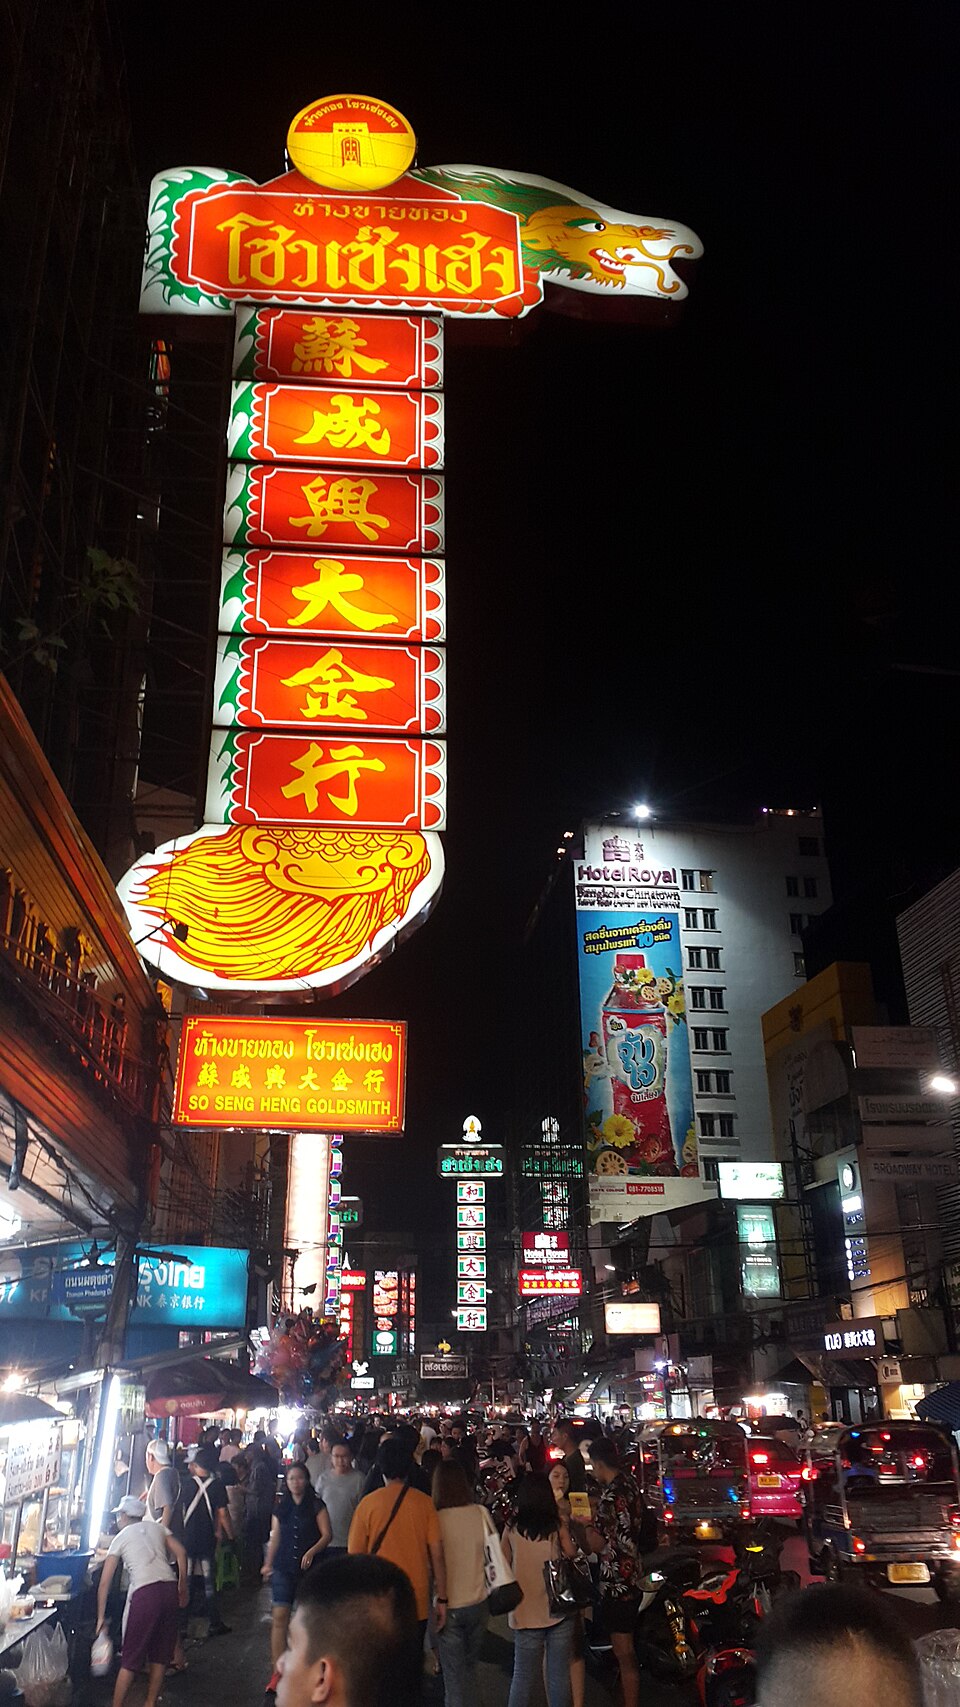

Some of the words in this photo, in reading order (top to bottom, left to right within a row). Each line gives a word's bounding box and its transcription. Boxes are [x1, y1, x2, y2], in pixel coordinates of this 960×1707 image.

[293, 198, 468, 223] ห้างขายทอง
[281, 316, 398, 817] 蘇成興大金行
[577, 864, 625, 882] Hotel
[628, 866, 677, 886] Royal
[635, 931, 654, 948] 10
[193, 1029, 294, 1059] ห้างขายทอง
[196, 1061, 385, 1094] 蘇成興大金行
[188, 1094, 209, 1110] SO
[214, 1095, 254, 1112] SENG
[260, 1097, 301, 1113] HENG
[306, 1098, 391, 1115] GOLDSMITH
[873, 1163, 923, 1176] BROADWAY
[926, 1164, 956, 1176] HOTEL
